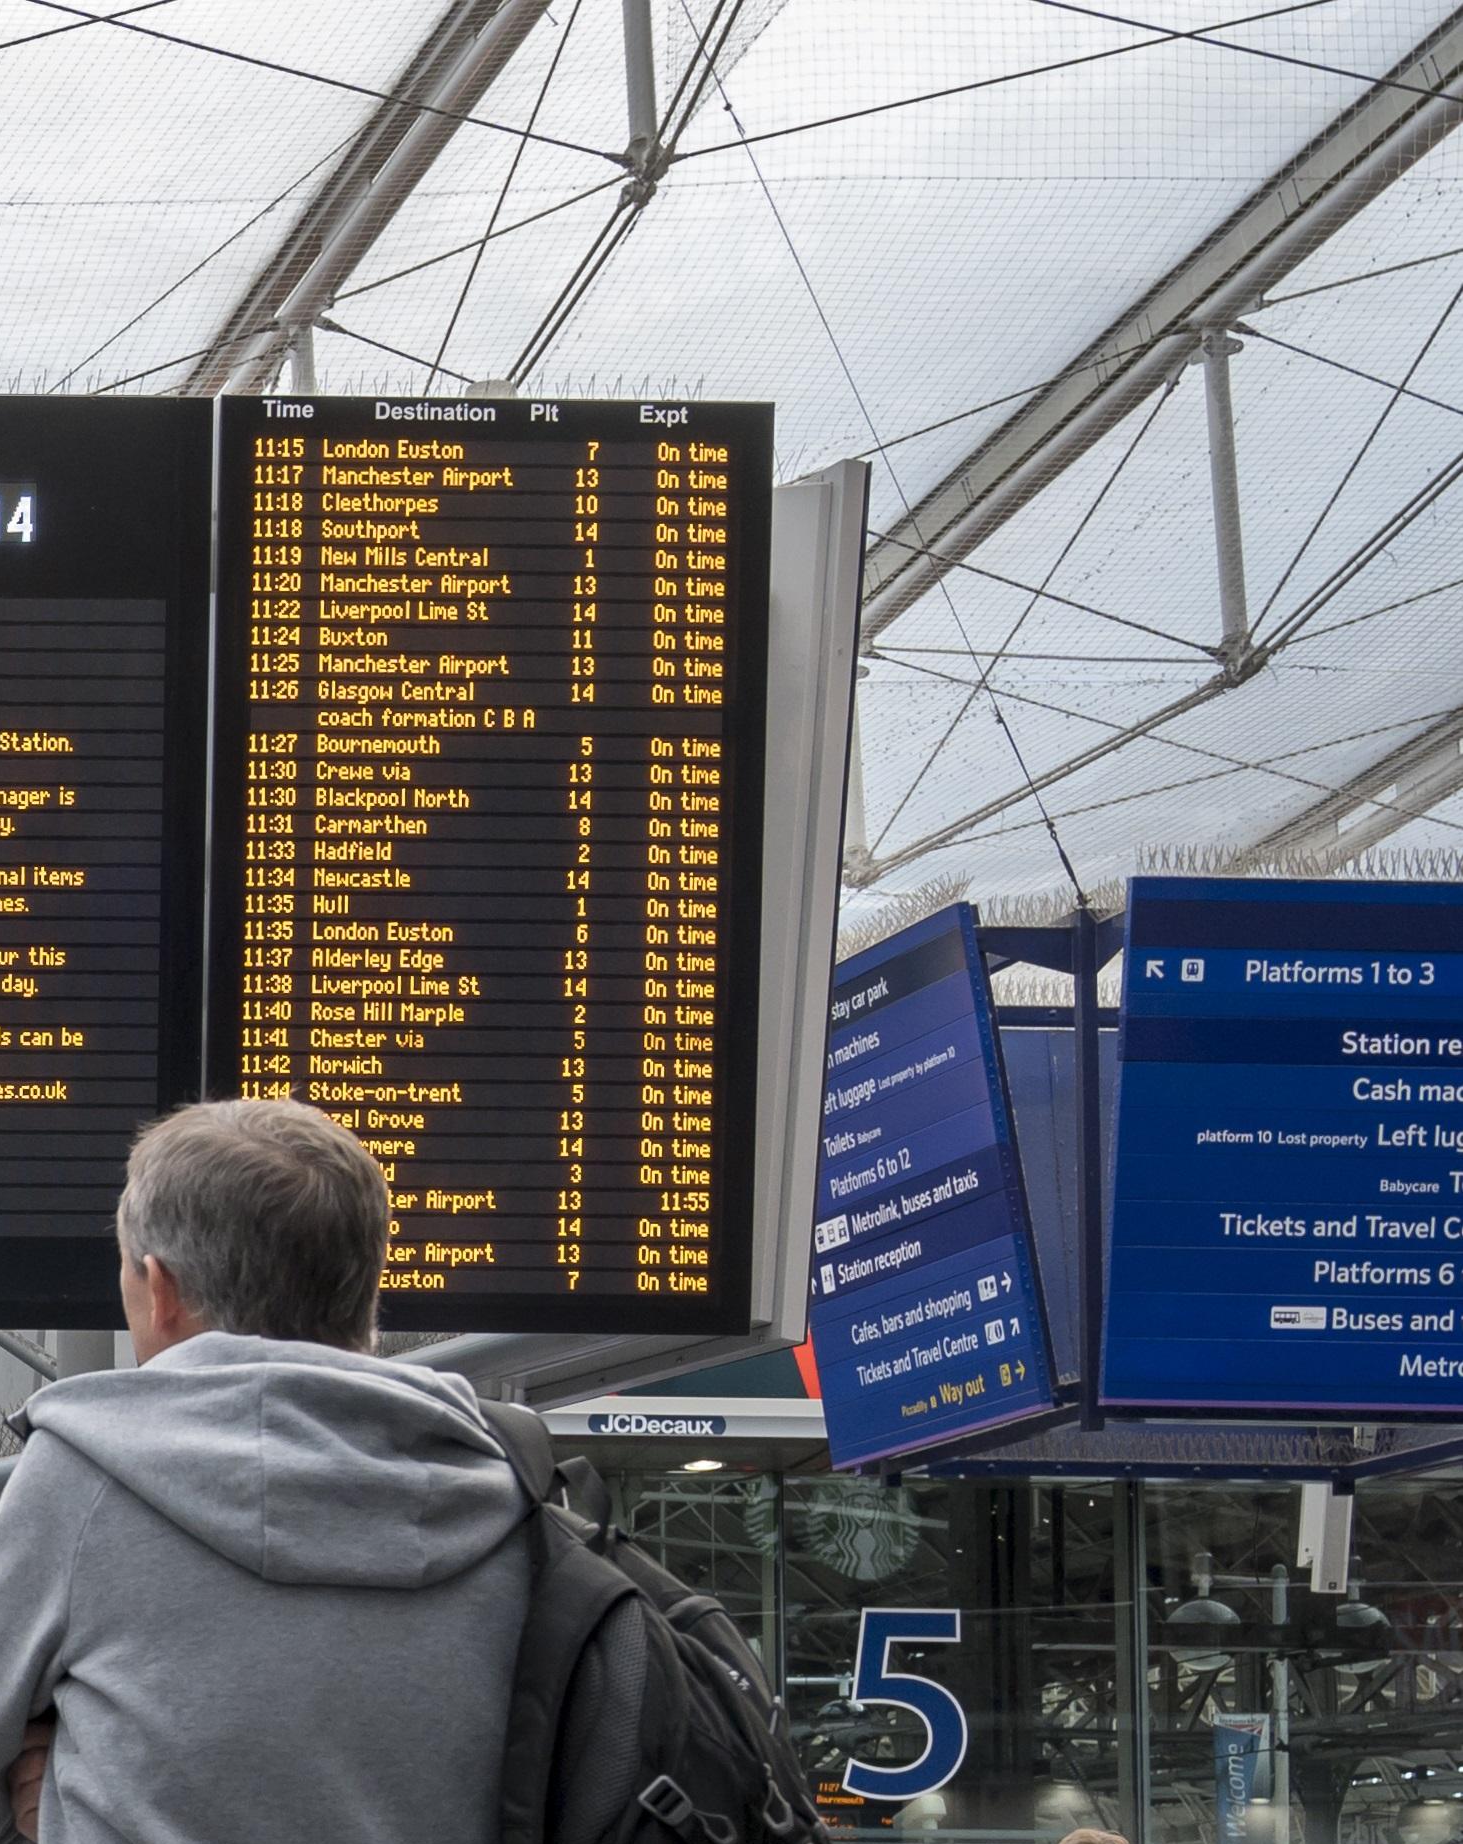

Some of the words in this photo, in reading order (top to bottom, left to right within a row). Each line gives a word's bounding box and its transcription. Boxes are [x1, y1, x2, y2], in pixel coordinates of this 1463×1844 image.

[262, 400, 314, 419] Time
[375, 402, 496, 422] Destination
[530, 404, 559, 422] Plt
[640, 406, 688, 428] Expt
[254, 437, 305, 458] 11:15
[322, 438, 390, 459] London
[396, 439, 464, 460] Euston
[587, 441, 600, 462] 7
[657, 441, 681, 462] On
[687, 442, 729, 463] time
[59, 785, 75, 806] is
[1246, 960, 1362, 984] Platforms
[1371, 962, 1380, 984] 1
[1387, 964, 1412, 984] to
[1419, 962, 1435, 985] 3
[831, 999, 850, 1020] stay
[852, 990, 866, 1010] car
[867, 977, 889, 1008] park
[835, 1031, 880, 1066] machines
[1342, 1031, 1430, 1056] Station
[838, 1078, 876, 1110] luggage
[1352, 1078, 1411, 1102] Cash
[823, 1131, 855, 1157] Toilets
[1197, 1128, 1253, 1145] platform
[1258, 1130, 1272, 1144] 10
[1278, 1131, 1307, 1145] Lost
[1310, 1132, 1368, 1149] property
[1378, 1123, 1426, 1146] Left
[830, 1166, 877, 1200] Platforms
[876, 1158, 886, 1180] 6
[886, 1159, 897, 1176] to
[898, 1148, 911, 1170] 12
[1380, 1179, 1440, 1196] Babycare
[852, 1197, 901, 1236] Metrolink,
[901, 1189, 931, 1216] buses
[933, 1177, 952, 1201] and
[952, 1169, 978, 1194] taxis
[1220, 1213, 1306, 1237] Tickets
[1313, 1216, 1356, 1238] and
[1365, 1215, 1436, 1238] Travel
[838, 1253, 873, 1285] Station
[874, 1240, 922, 1271] reception
[1314, 1260, 1430, 1285] Platforms
[1438, 1262, 1454, 1286] 6
[851, 1320, 882, 1345] Cafes,
[881, 1314, 904, 1335] bars
[904, 1302, 924, 1326] and
[925, 1290, 972, 1320] shopping
[1332, 1308, 1402, 1330] Buses
[1410, 1309, 1454, 1332] and
[856, 1358, 892, 1386] Tickets
[893, 1351, 912, 1376] and
[912, 1340, 942, 1367] Travel
[943, 1332, 978, 1358] Centre
[939, 1382, 962, 1405] Way
[966, 1374, 986, 1397] out
[600, 1414, 714, 1434] JCDecaux
[842, 1607, 968, 1801] 5
[1226, 1744, 1246, 1838] Welcome
